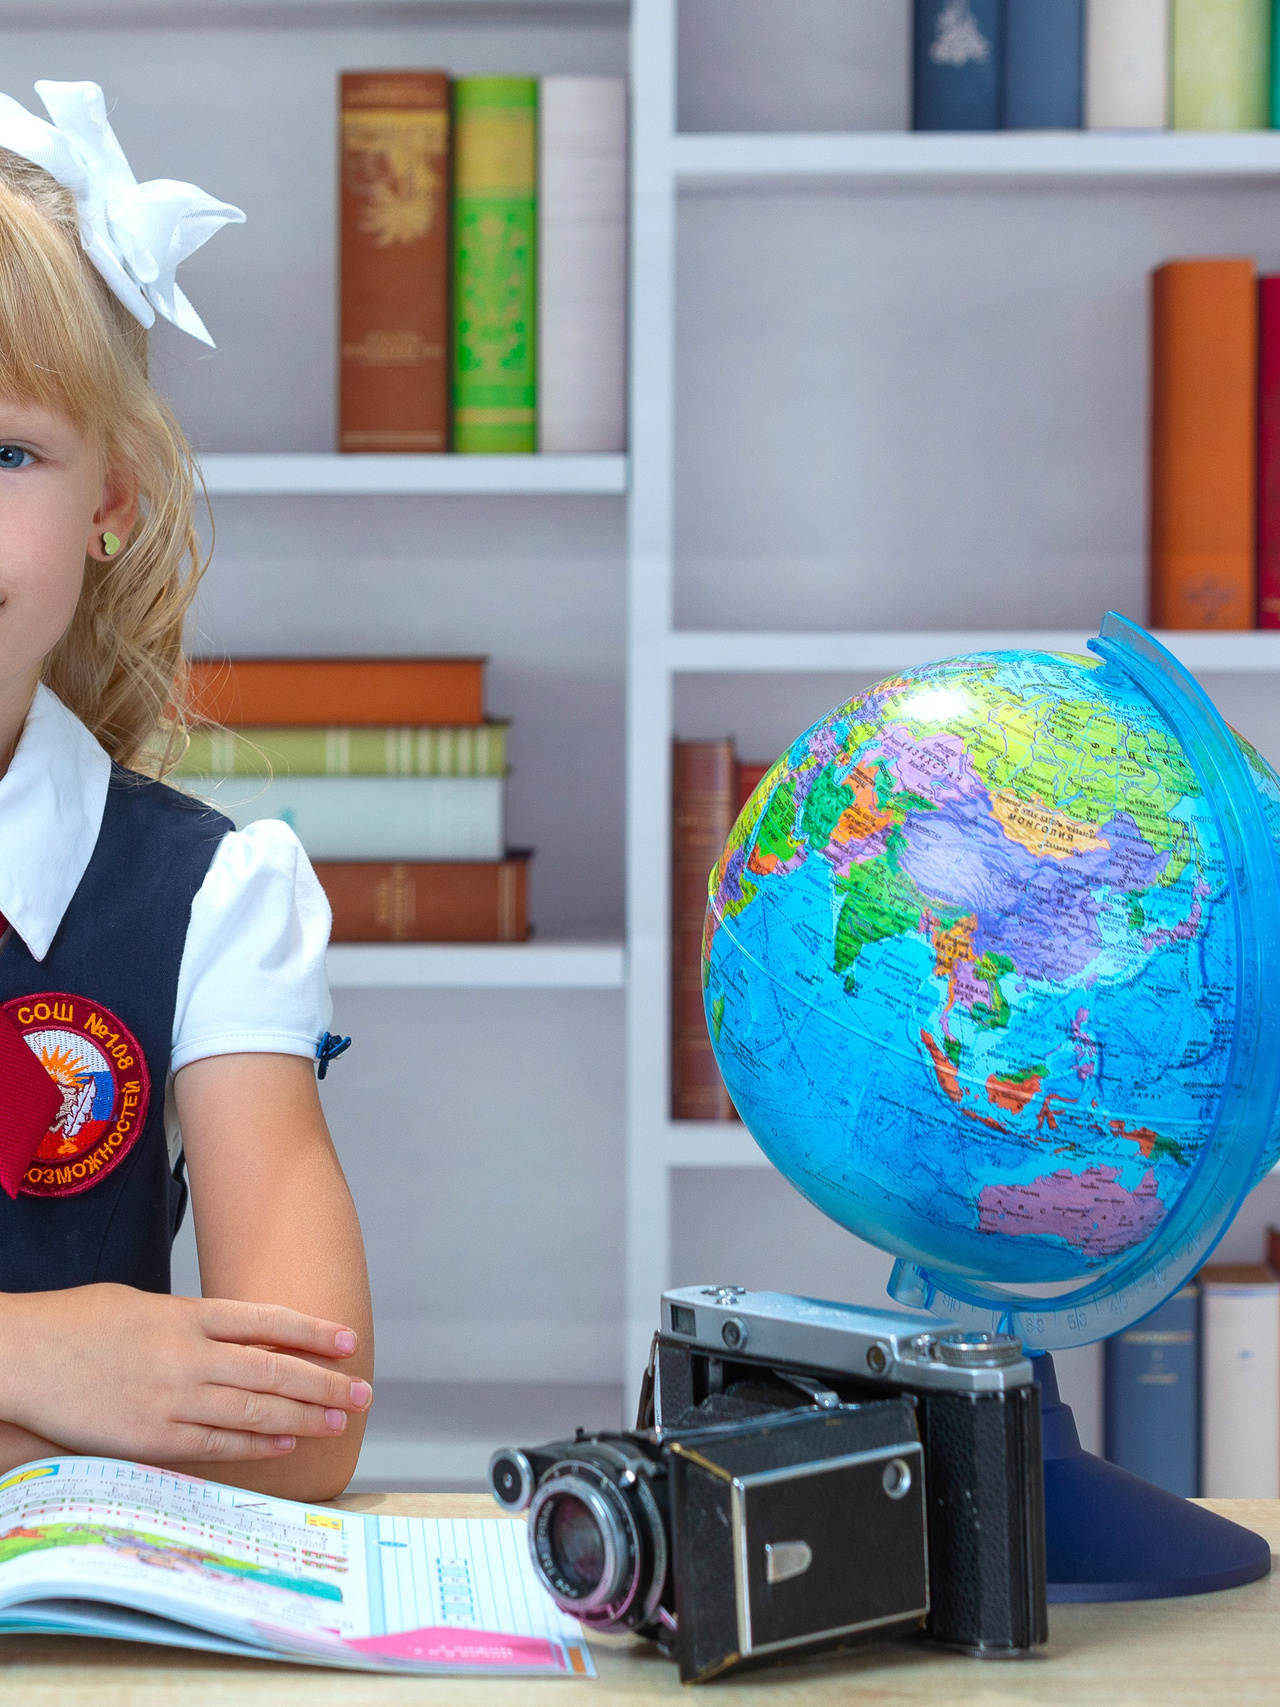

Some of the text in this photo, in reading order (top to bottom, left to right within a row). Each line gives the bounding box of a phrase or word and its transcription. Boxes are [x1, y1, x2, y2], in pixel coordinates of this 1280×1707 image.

[901, 741, 963, 783] КАЗАХСТАН
[1008, 812, 1074, 843] МОНГОЛИЯ
[18, 1002, 134, 1070] СОШ №108
[23, 1080, 141, 1185] ОЗМОЖНОСТЕЙ
[1025, 1316, 1045, 1334] 60
[1067, 1311, 1088, 1330] 50
